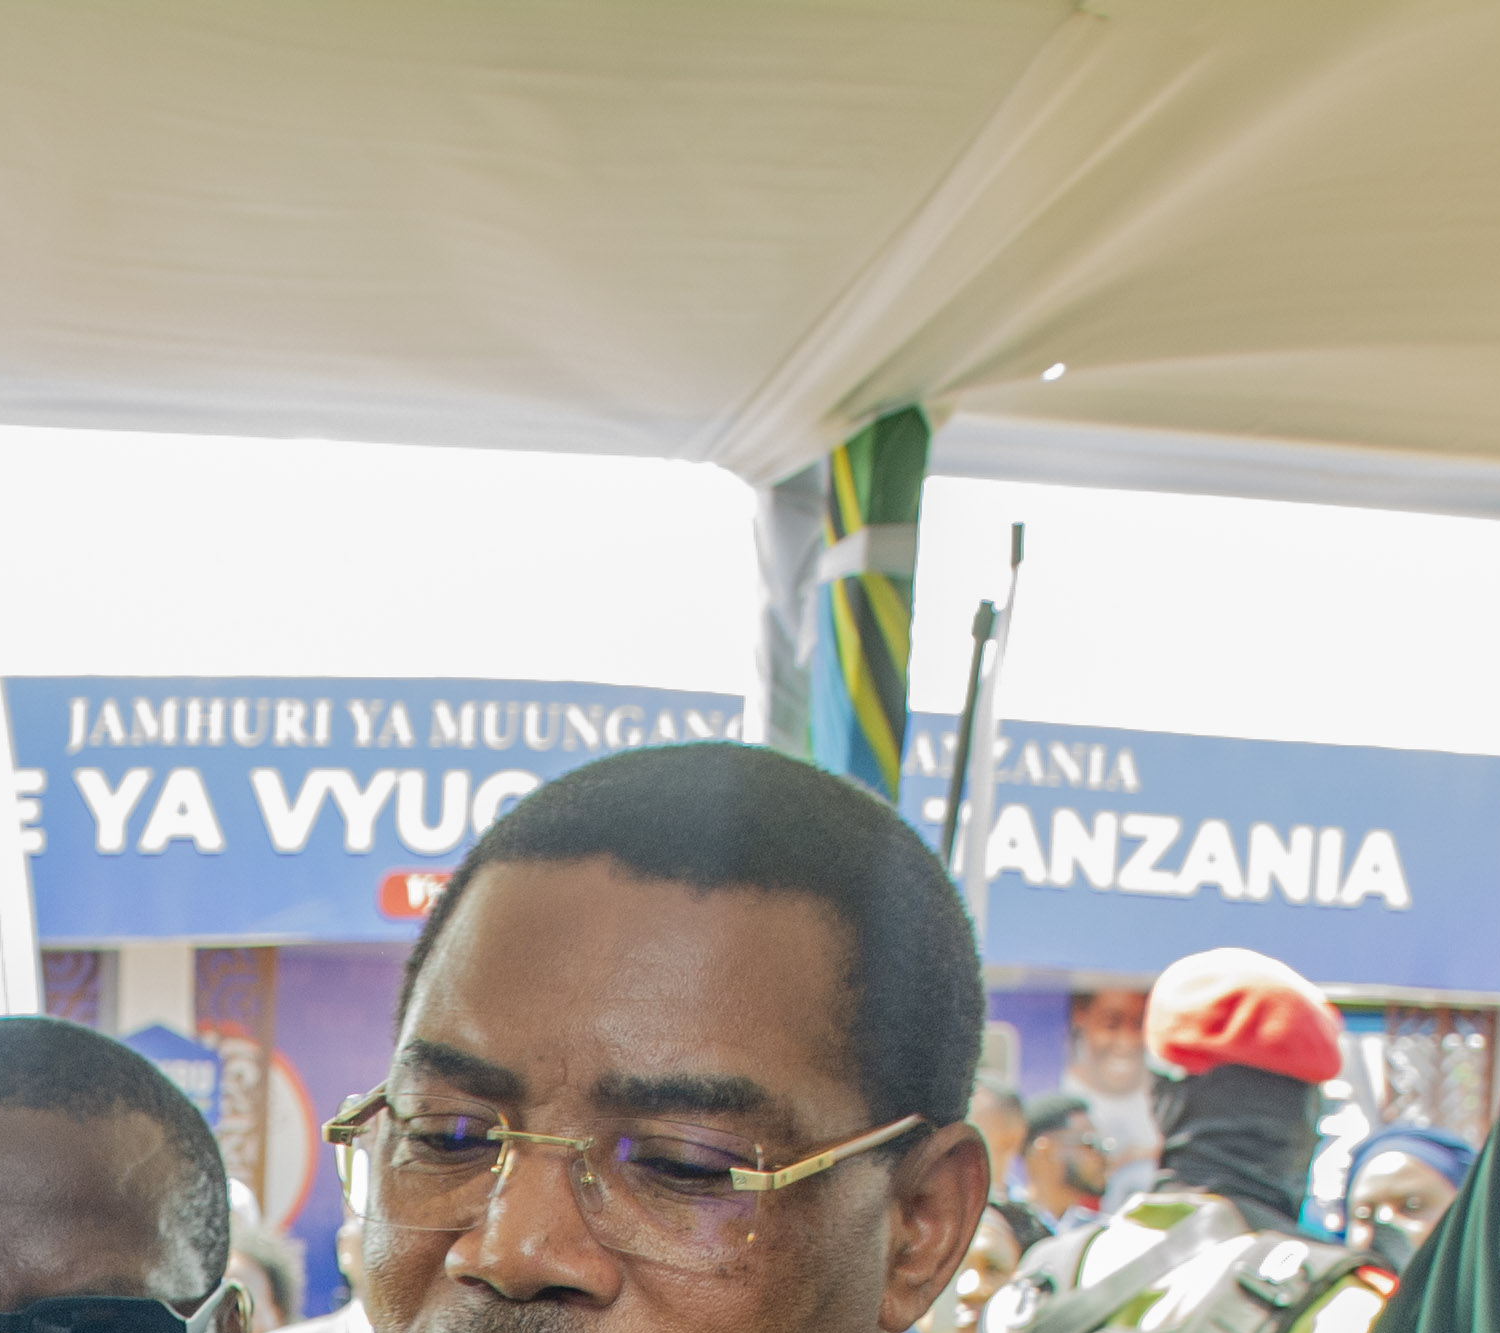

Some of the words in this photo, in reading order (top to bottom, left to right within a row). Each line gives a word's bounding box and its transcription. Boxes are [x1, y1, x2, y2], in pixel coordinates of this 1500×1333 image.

[66, 697, 333, 754] JAMHURI
[346, 699, 415, 748] YA
[72, 766, 227, 855] YA
